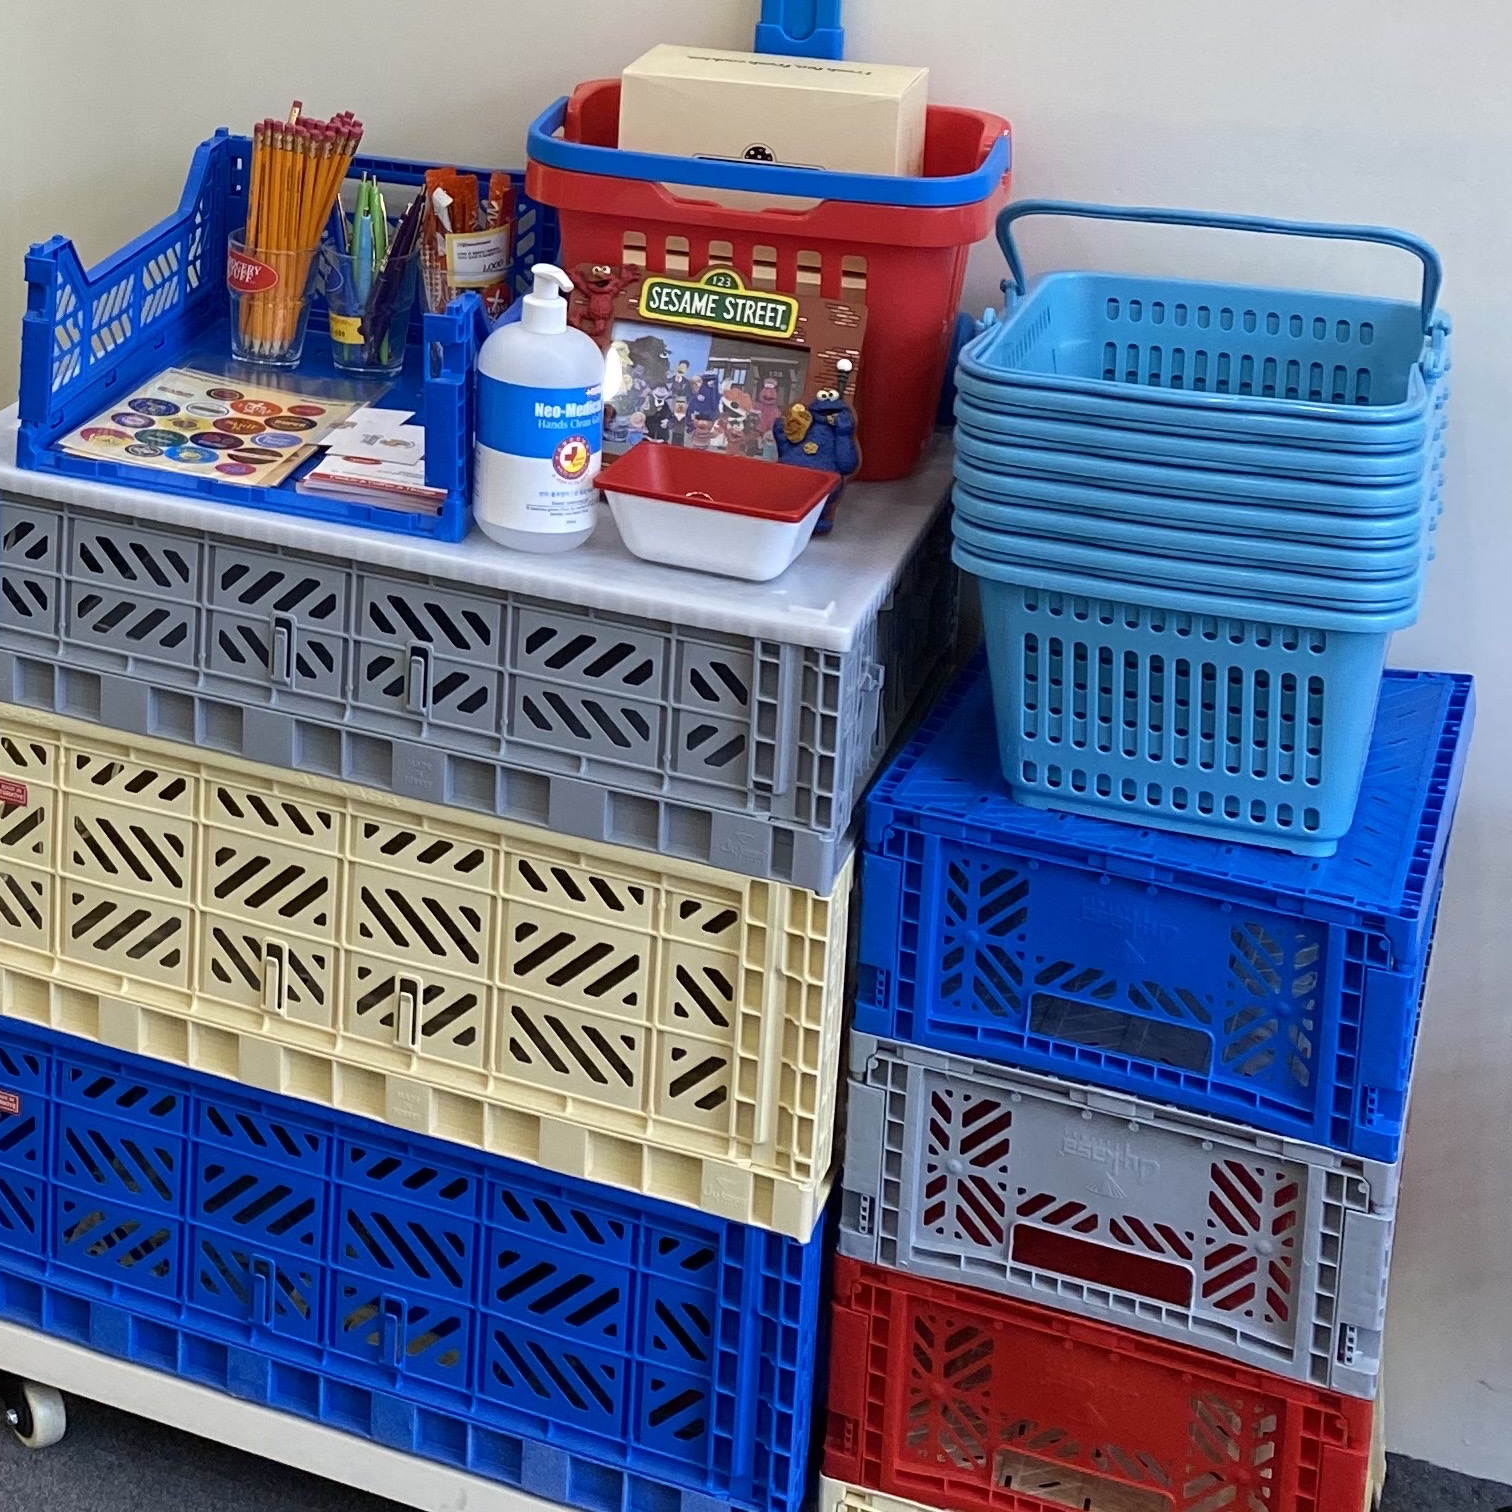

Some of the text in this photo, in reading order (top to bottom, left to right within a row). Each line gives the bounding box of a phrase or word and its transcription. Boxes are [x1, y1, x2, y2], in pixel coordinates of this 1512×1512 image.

[711, 275, 732, 289] 123
[649, 285, 787, 330] SESAME STREET
[539, 419, 568, 430] Hands
